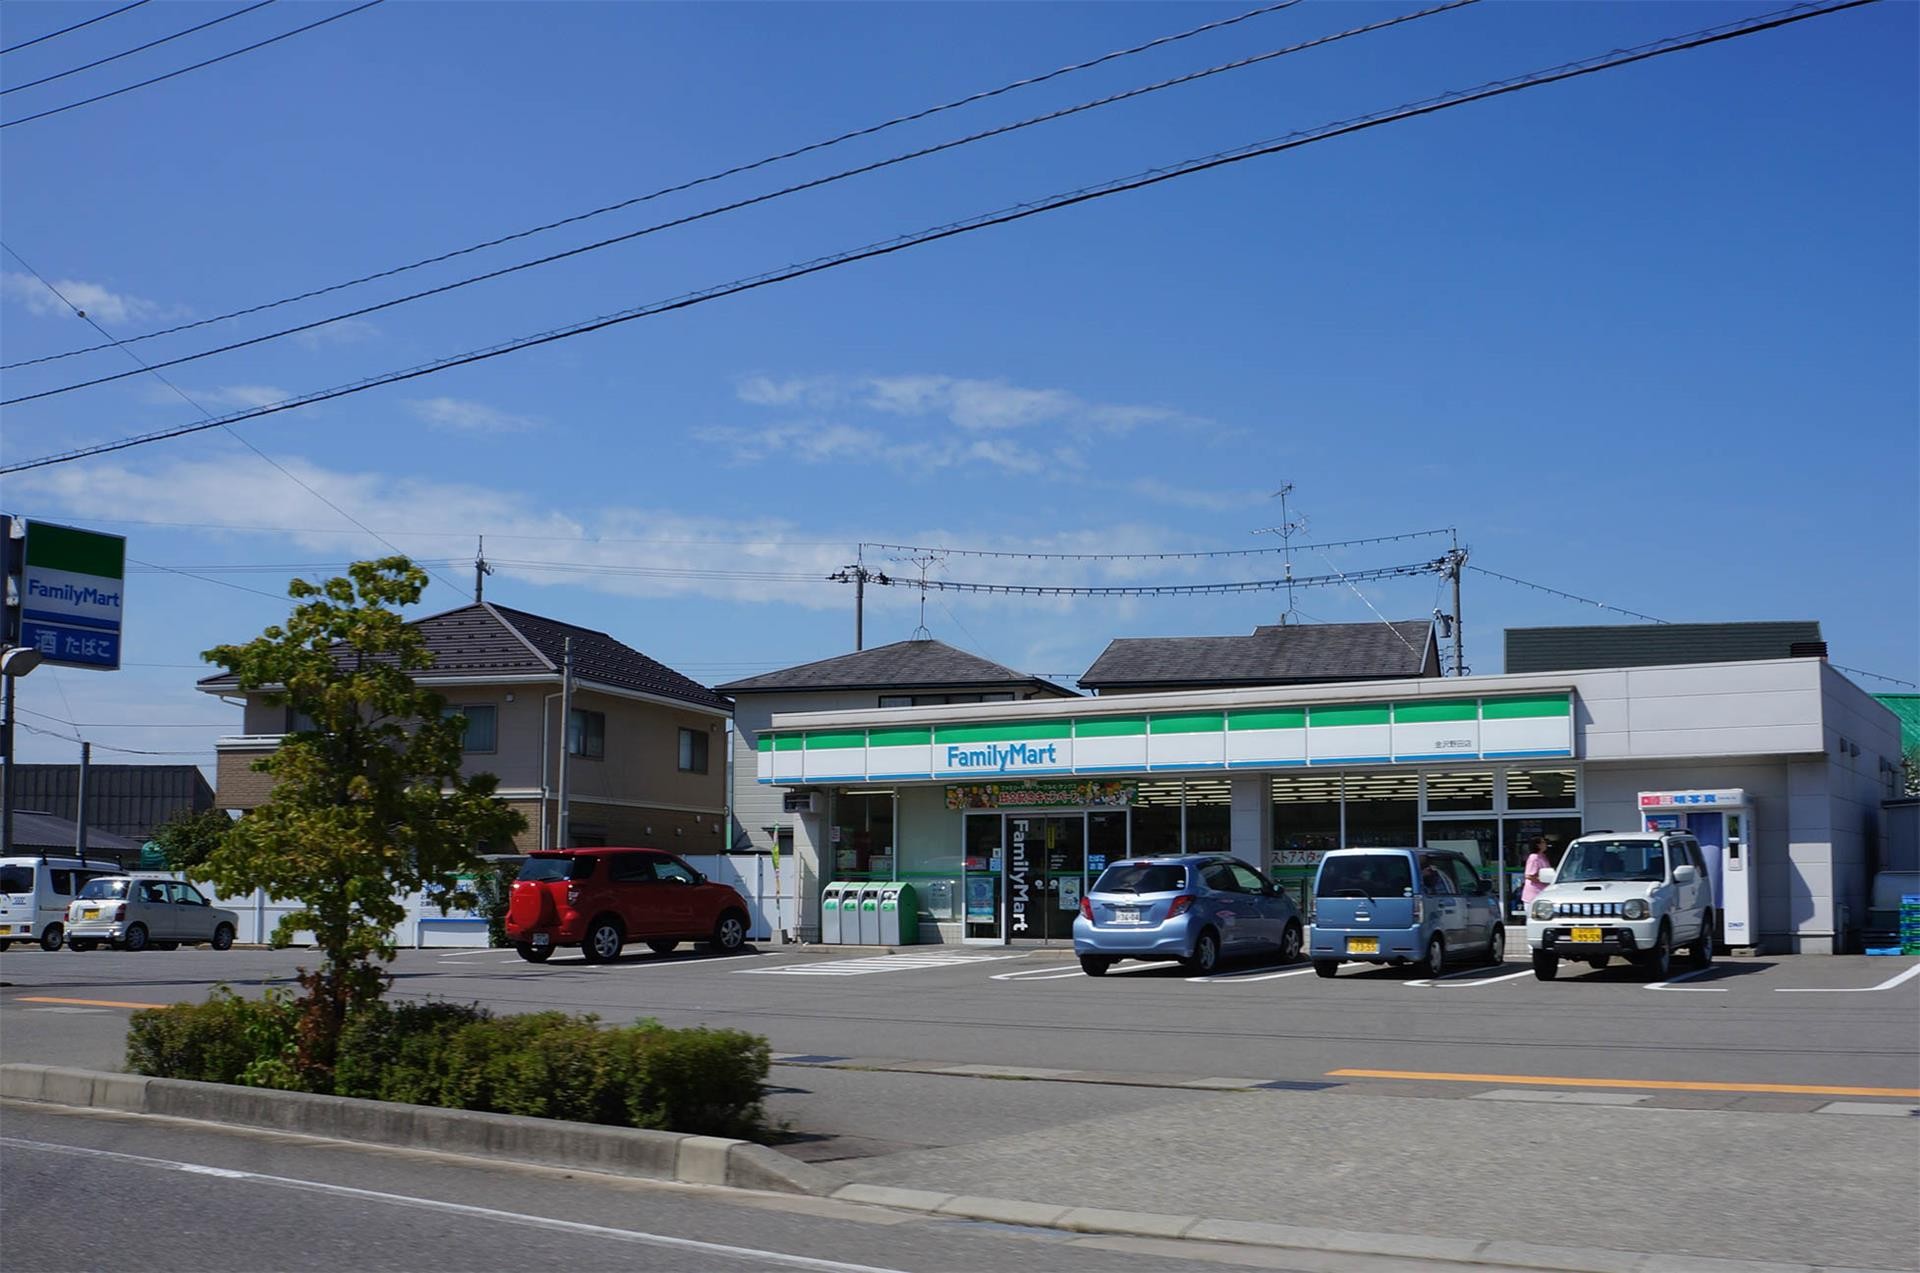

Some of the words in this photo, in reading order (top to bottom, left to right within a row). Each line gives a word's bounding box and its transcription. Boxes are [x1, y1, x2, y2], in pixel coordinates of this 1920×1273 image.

[28, 578, 120, 607] FamilyMart
[34, 629, 57, 655] 酒
[65, 635, 111, 658] たばこ
[947, 742, 1056, 772] FamilyMart
[1009, 820, 1029, 931] FamilyMart
